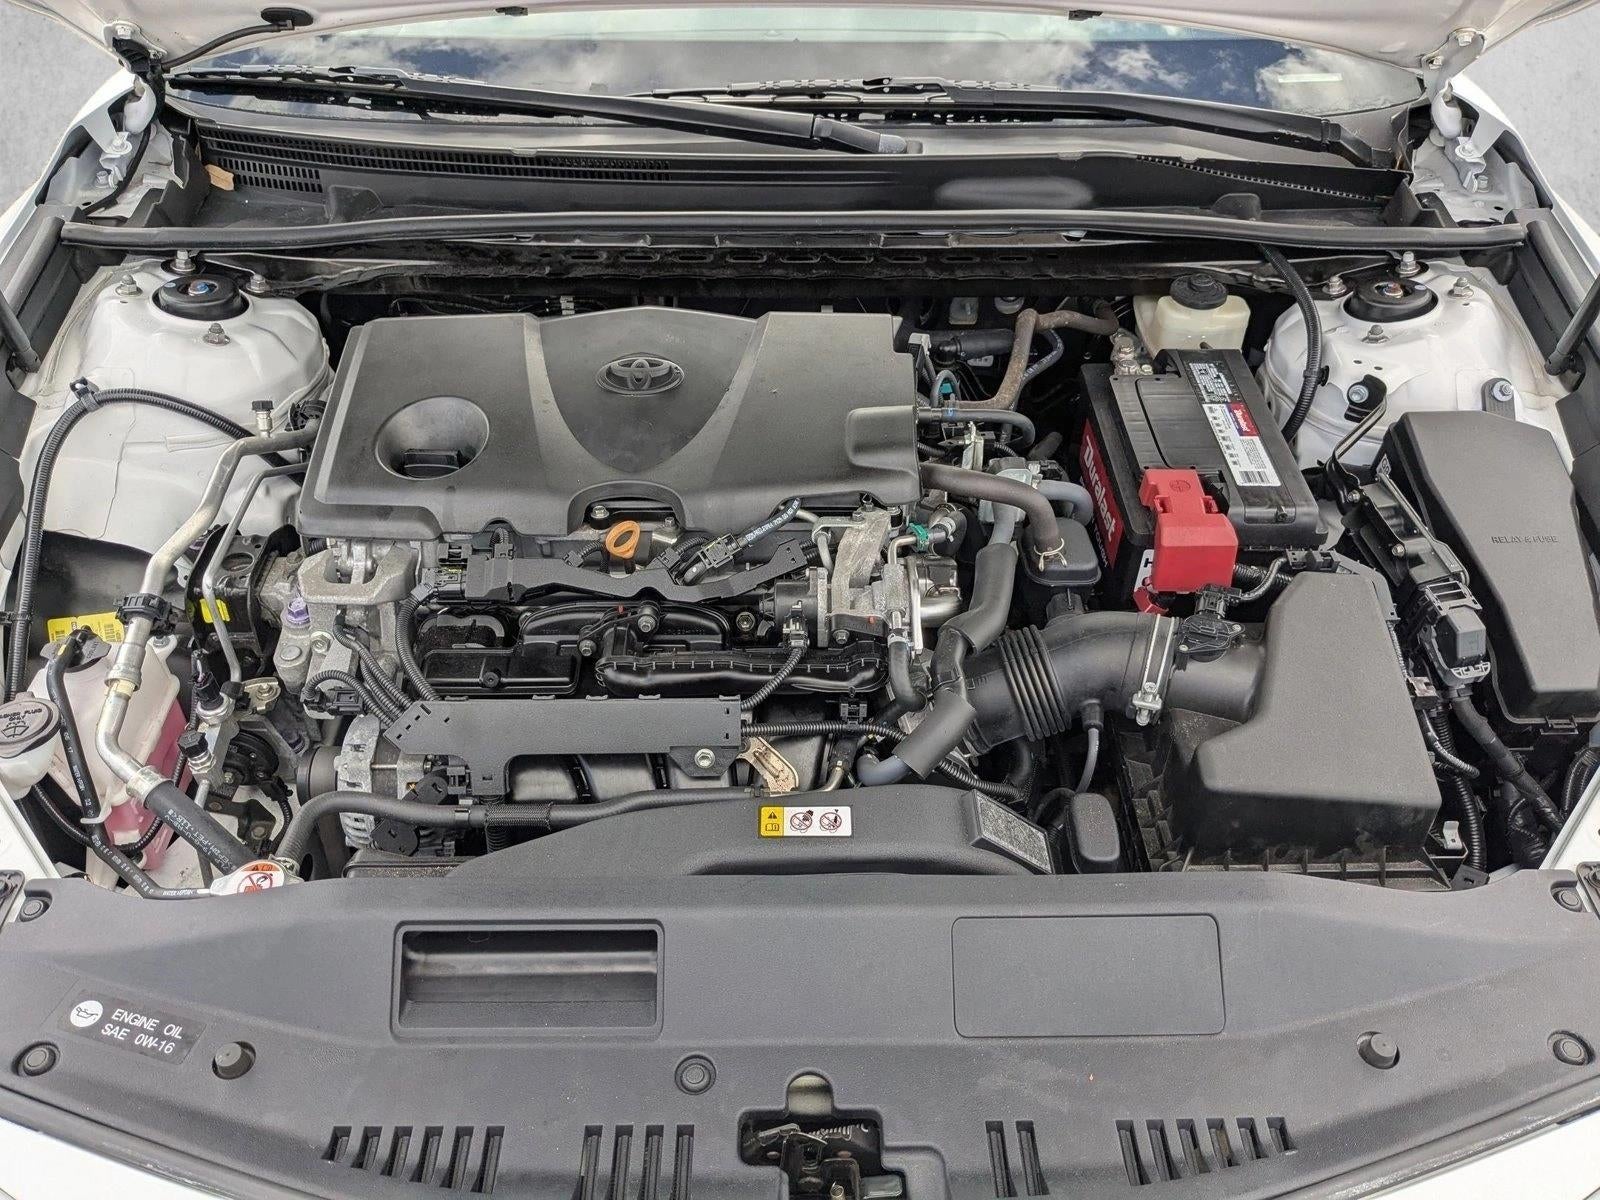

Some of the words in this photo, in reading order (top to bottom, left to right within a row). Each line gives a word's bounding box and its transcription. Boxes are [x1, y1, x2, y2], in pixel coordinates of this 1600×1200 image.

[1083, 435, 1116, 542] Duralast
[1491, 535, 1522, 544] RELAY
[1532, 535, 1559, 543] FUSE
[101, 1023, 130, 1040] SAE
[134, 1033, 175, 1054] 0W-16
[111, 1008, 160, 1031] ENGINE
[163, 1023, 183, 1039] OIL
